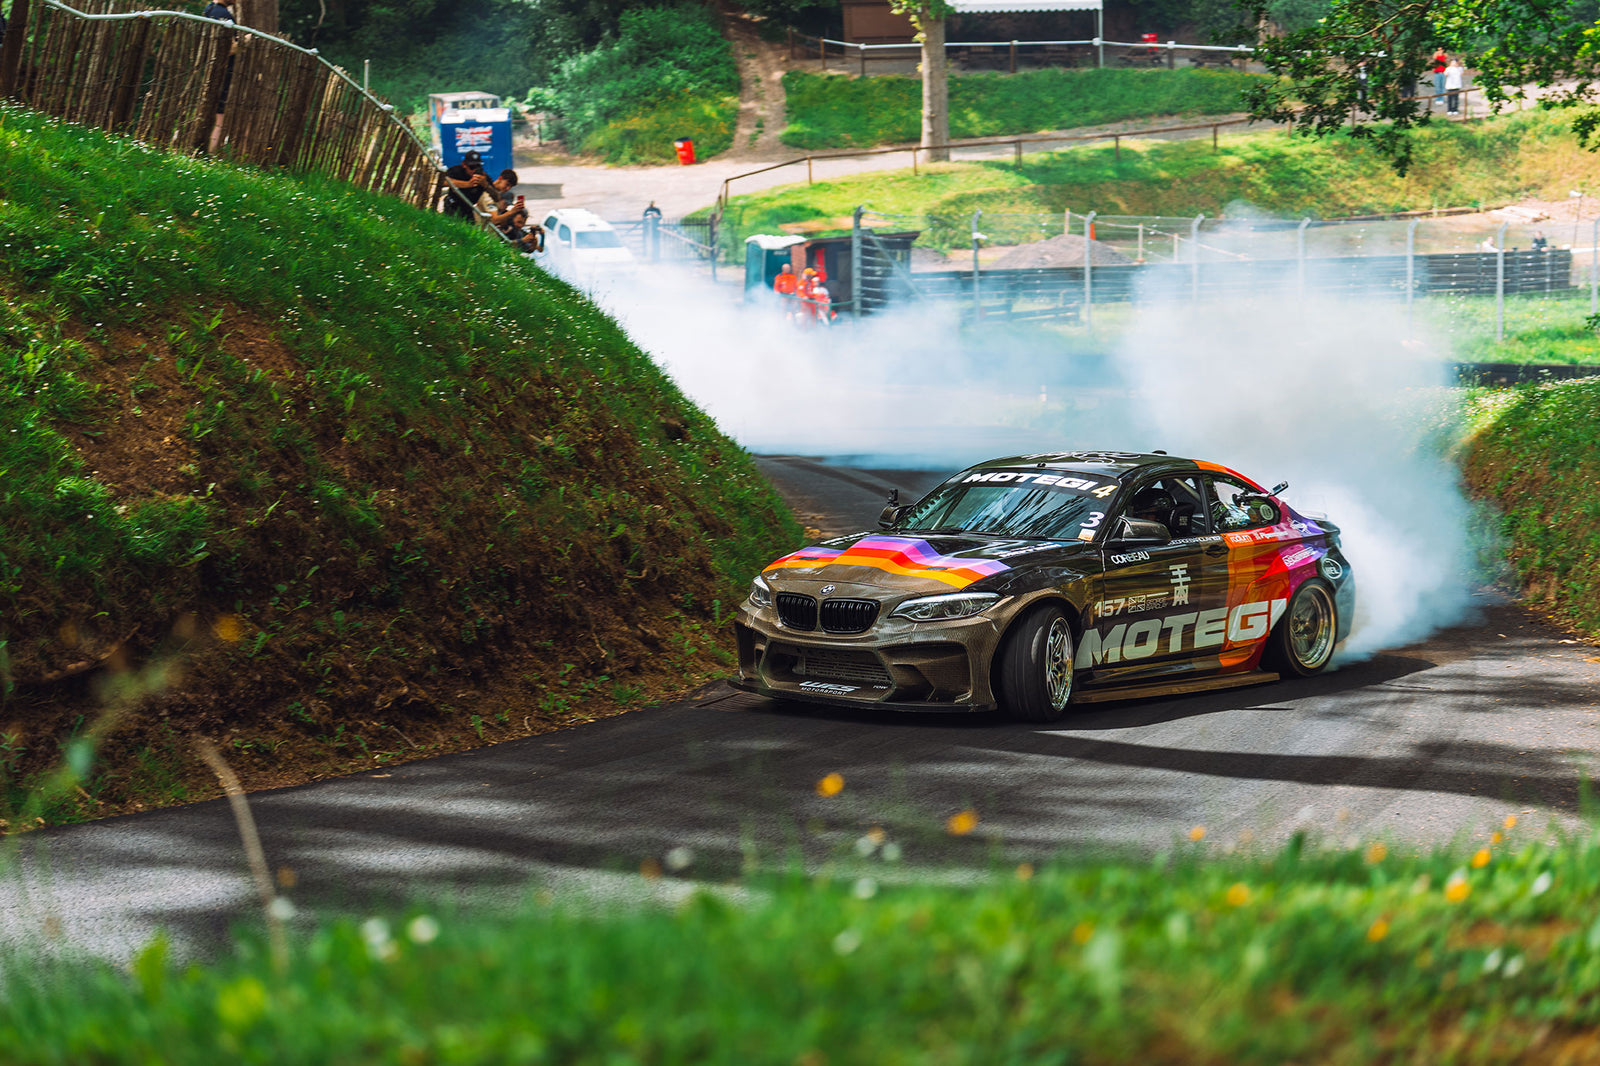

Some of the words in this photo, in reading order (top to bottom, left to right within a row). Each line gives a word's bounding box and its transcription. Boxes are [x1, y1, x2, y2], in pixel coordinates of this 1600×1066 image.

[961, 472, 1099, 491] MOTEGI
[1091, 484, 1118, 499] 4
[1079, 511, 1105, 528] 3
[1110, 550, 1150, 565] CORBEAU
[1094, 598, 1126, 618] 157
[1074, 598, 1287, 670] MOTEGI
[801, 687, 847, 696] MOTORSPORT
